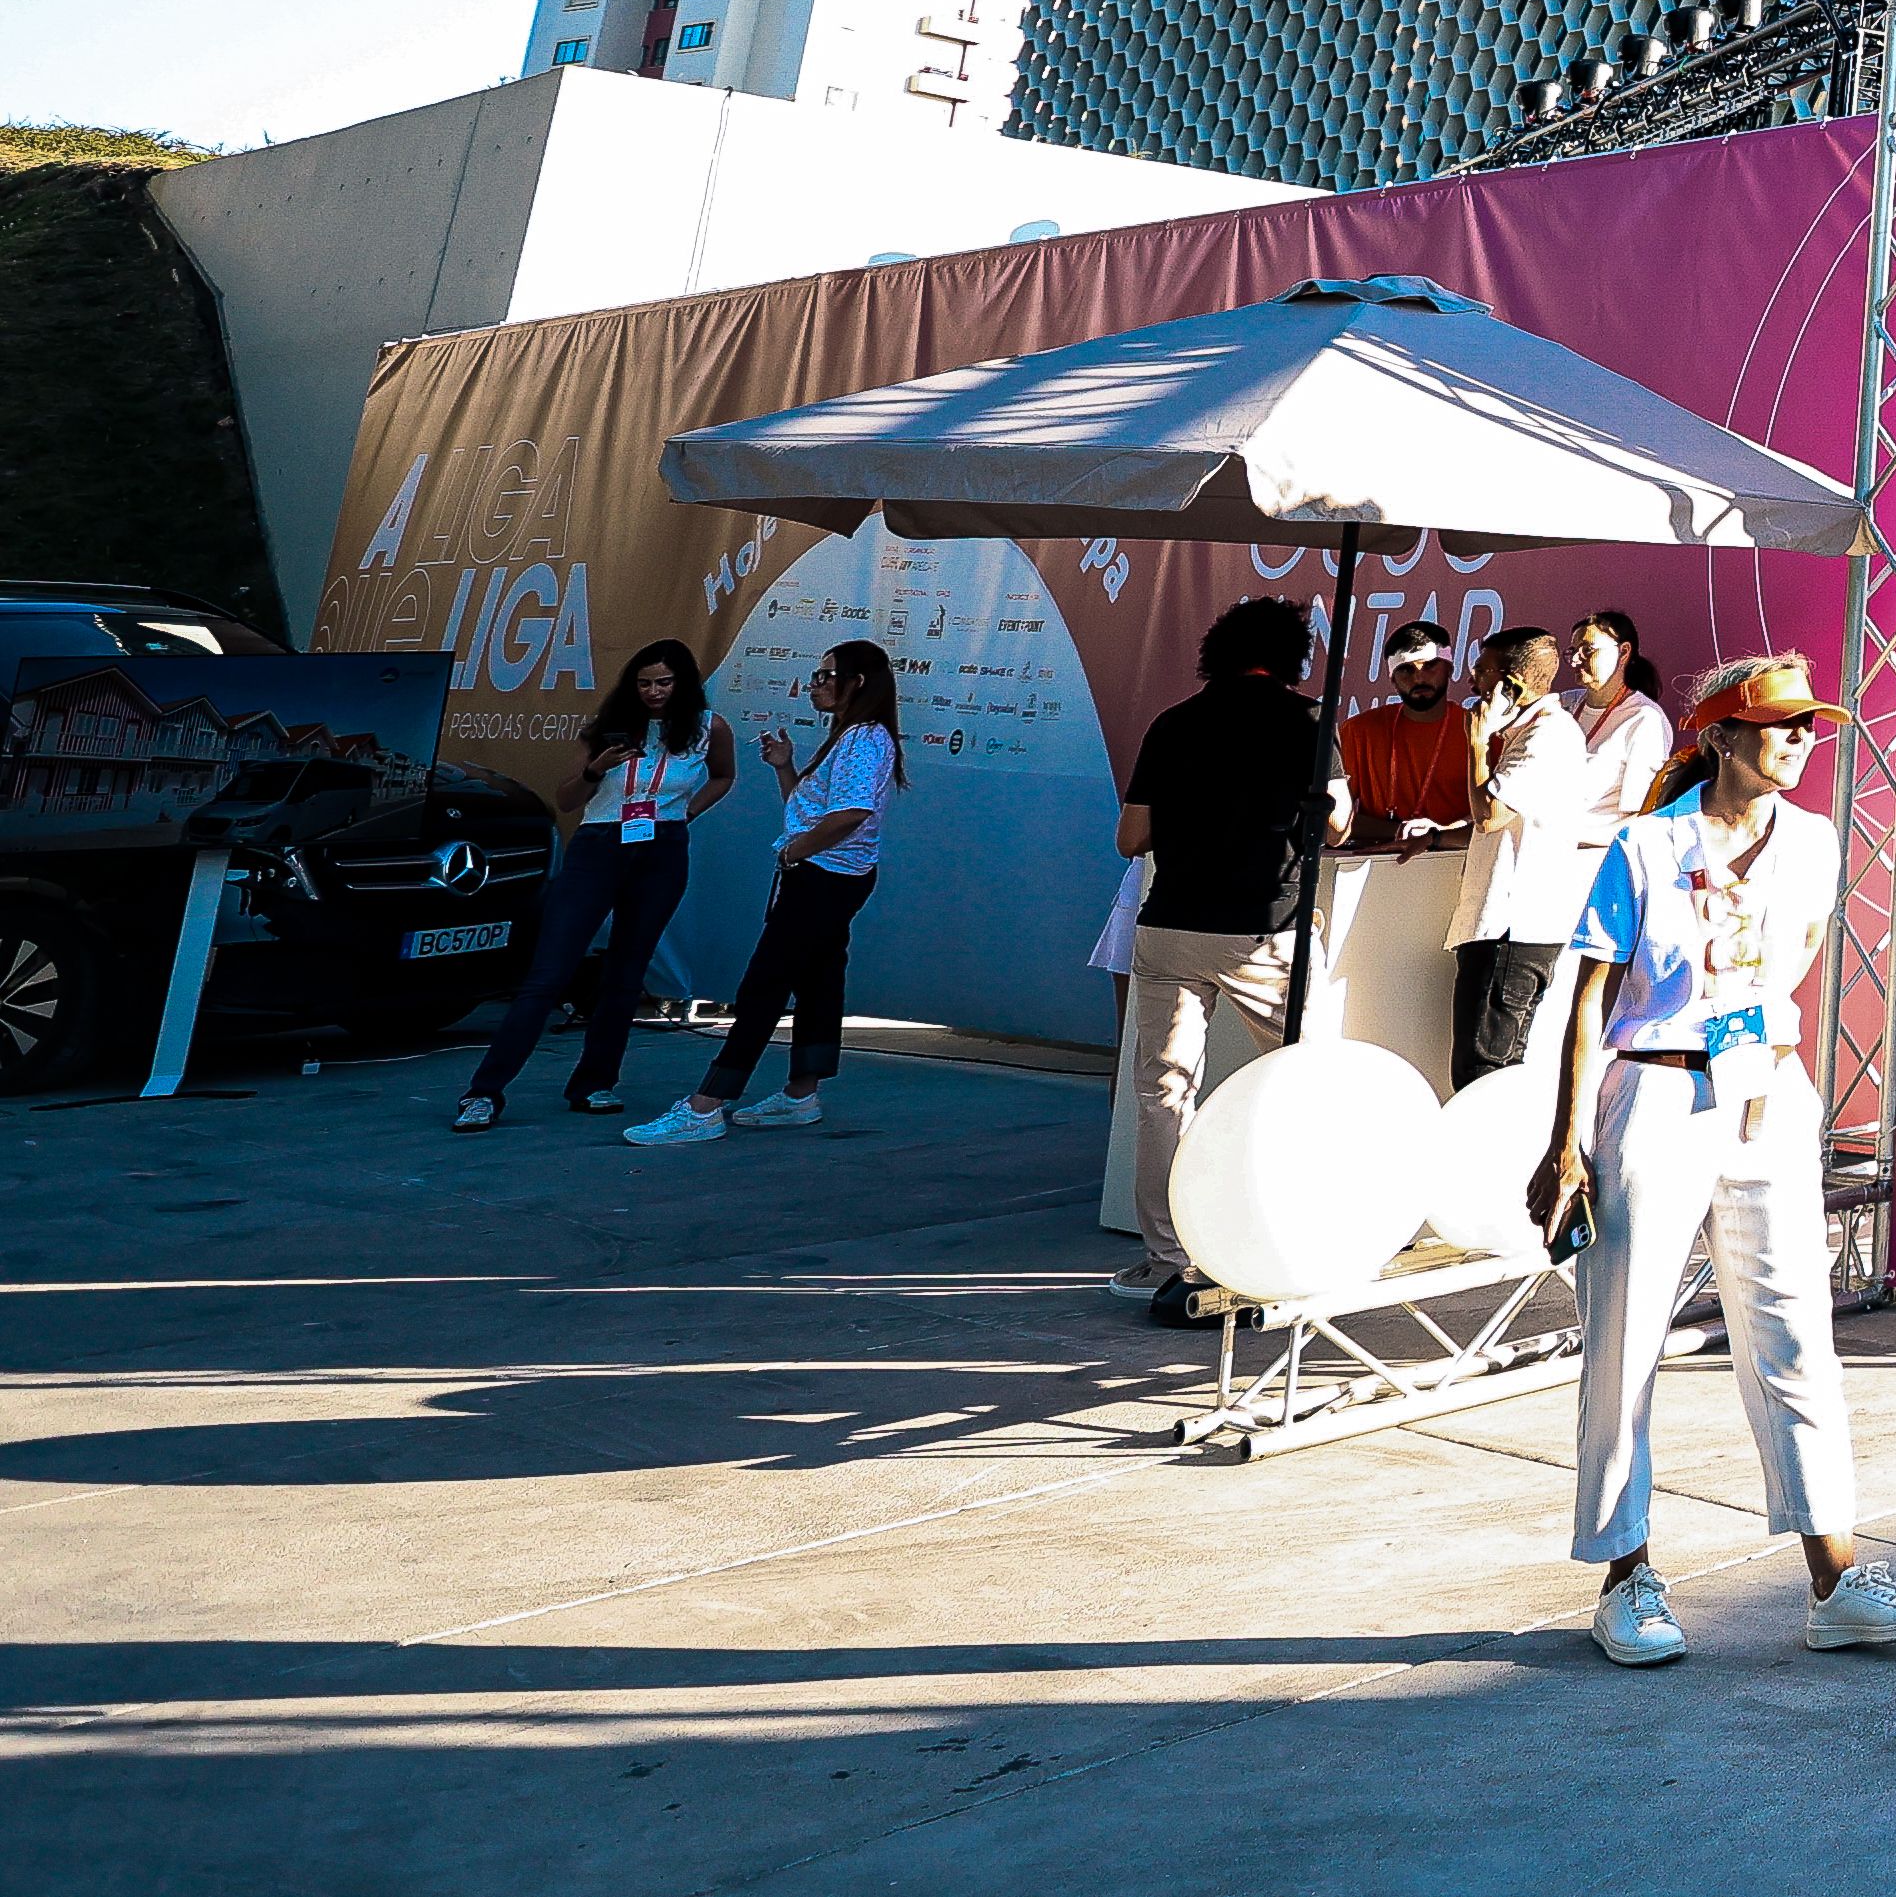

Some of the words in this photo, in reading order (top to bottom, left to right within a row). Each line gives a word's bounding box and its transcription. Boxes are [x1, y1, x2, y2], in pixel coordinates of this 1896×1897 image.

[357, 453, 429, 570] A
[415, 436, 580, 566] LIGA
[441, 562, 596, 692] LIGA
